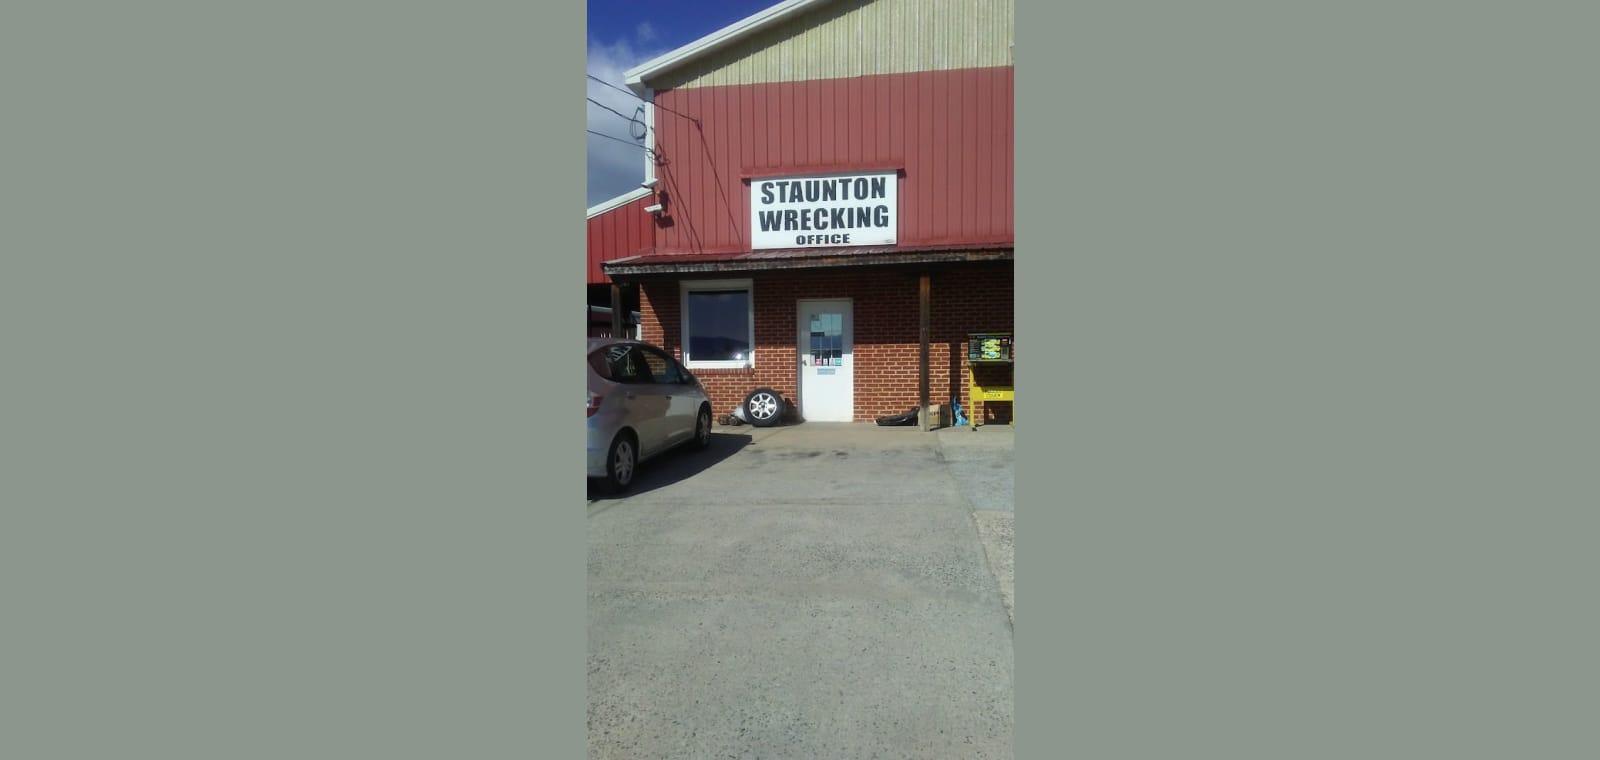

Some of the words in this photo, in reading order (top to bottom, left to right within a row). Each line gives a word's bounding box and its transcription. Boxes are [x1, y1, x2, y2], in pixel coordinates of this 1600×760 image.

[761, 177, 886, 205] STAUNTON
[759, 205, 889, 232] WRECKING
[795, 233, 850, 245] OFFICE
